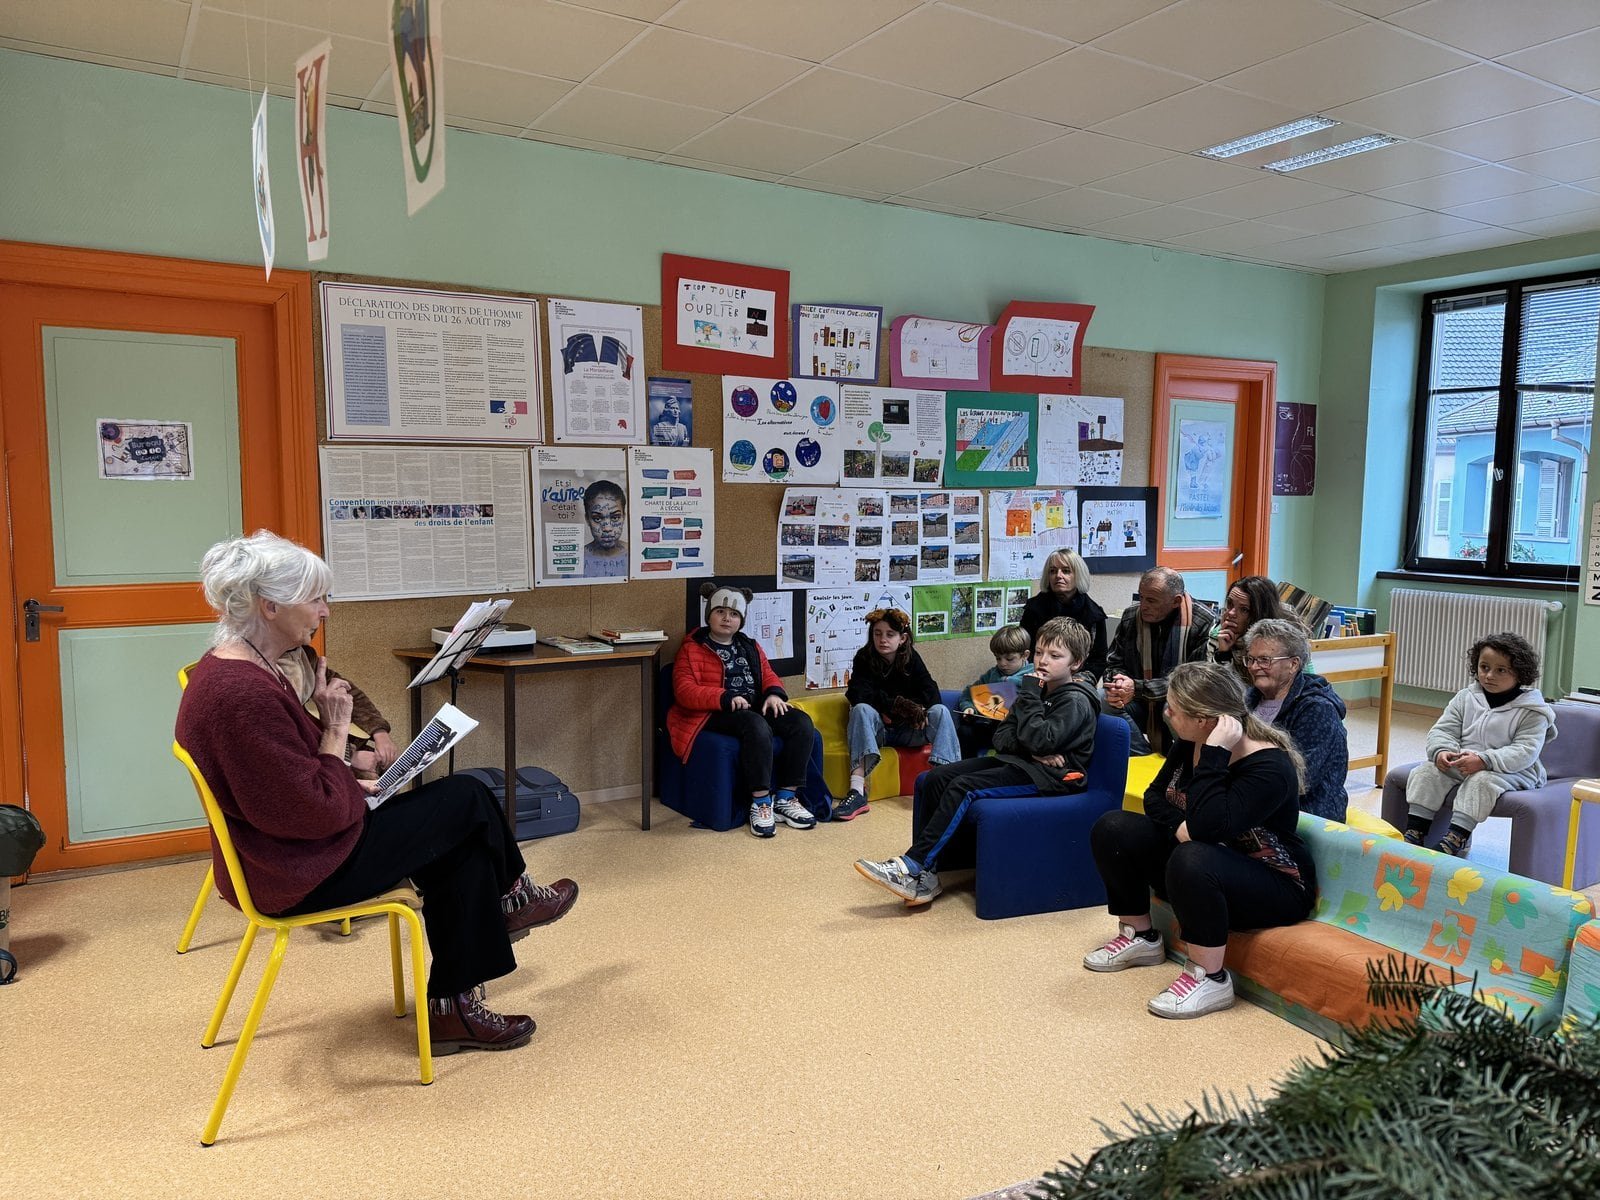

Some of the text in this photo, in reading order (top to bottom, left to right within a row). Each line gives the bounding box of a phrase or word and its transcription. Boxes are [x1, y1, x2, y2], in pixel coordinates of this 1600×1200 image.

[339, 296, 524, 320] DÉCLARATION DES DROITS DE L'HOMME
[353, 308, 512, 328] ET DU CITOYEN DU 26 AOÛT 1789
[555, 479, 572, 488] Et si
[329, 498, 376, 506] Convention
[557, 511, 569, 520] toi
[428, 518, 451, 527] droits
[453, 518, 463, 526] de
[464, 518, 494, 526] l'enfant
